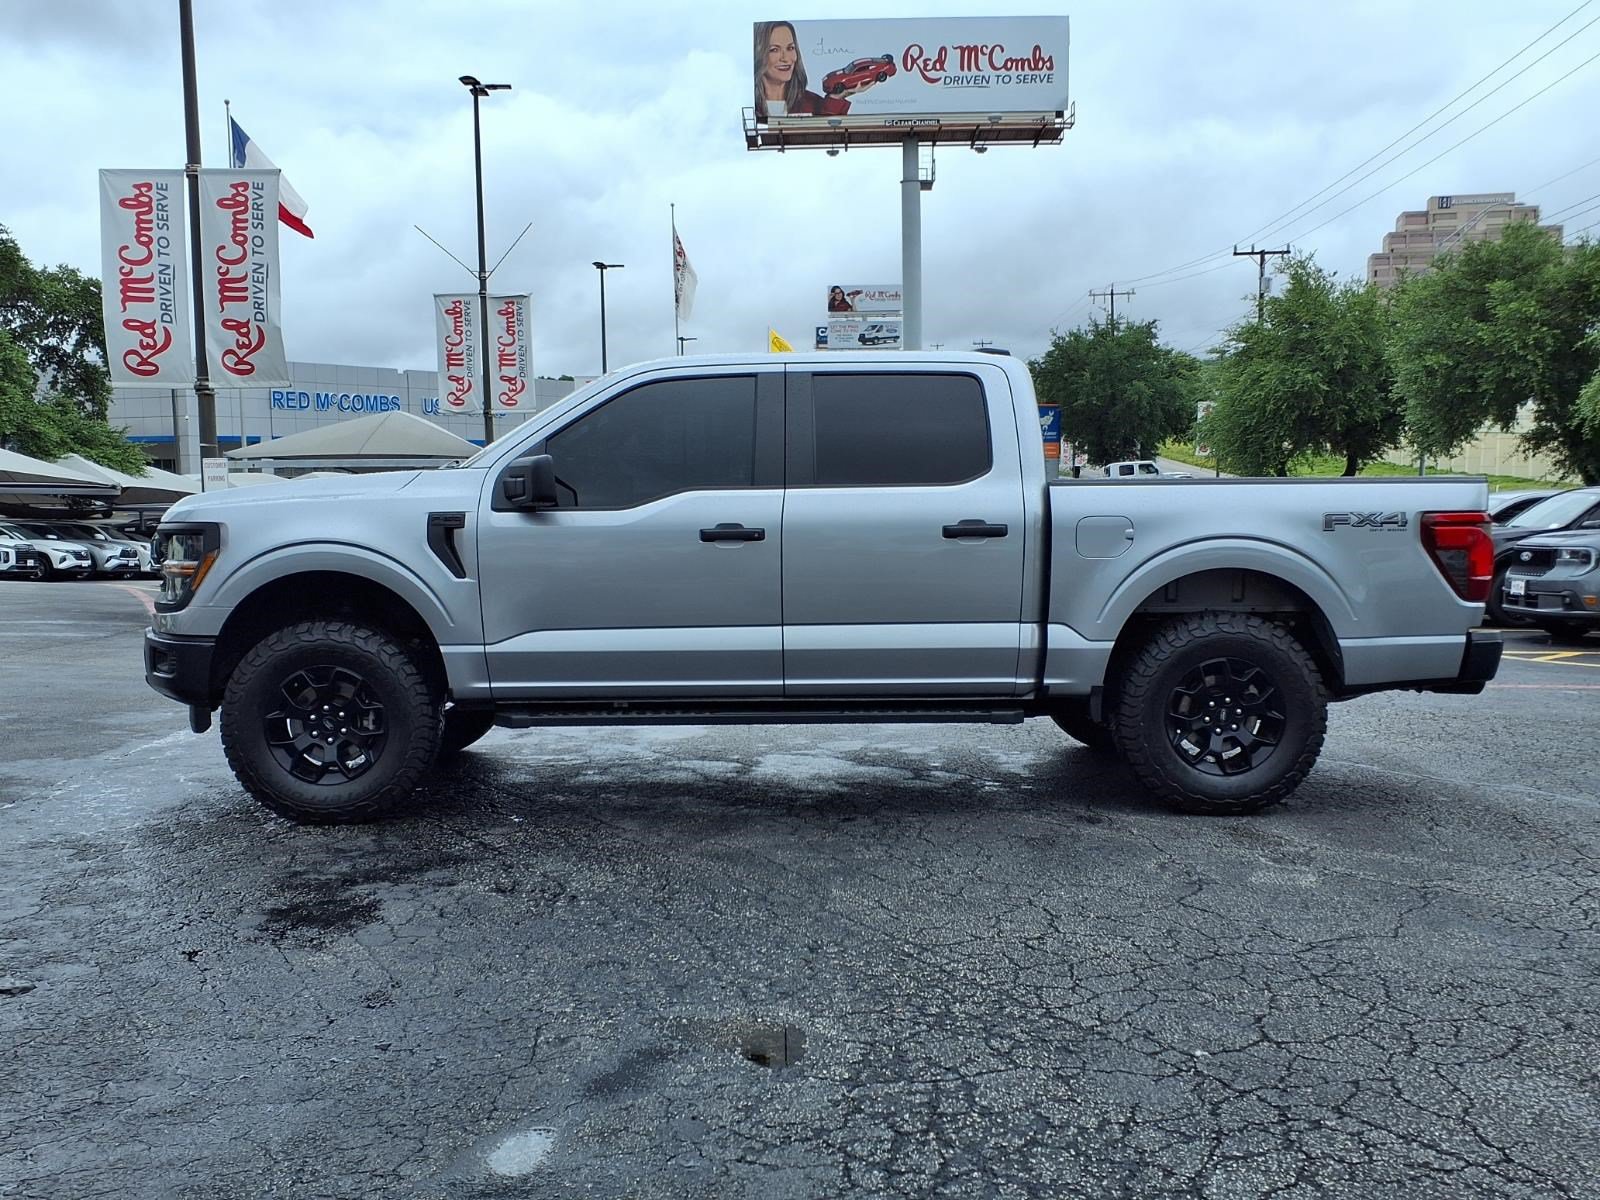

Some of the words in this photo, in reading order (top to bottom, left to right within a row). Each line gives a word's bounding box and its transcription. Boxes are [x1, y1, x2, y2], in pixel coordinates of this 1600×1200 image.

[902, 43, 948, 83] Red
[952, 44, 1054, 72] McCombs
[943, 75, 990, 86] DRIVEN
[994, 75, 1012, 85] TO
[1016, 74, 1054, 84] SERVE
[156, 182, 170, 231] SERVE
[252, 181, 264, 231] SERVE
[118, 181, 155, 313] McCombs
[157, 236, 170, 258] TO
[216, 181, 250, 313] McCombs
[252, 236, 265, 257] TO
[157, 264, 173, 324] DRIVEN
[253, 263, 265, 323] DRIVEN
[123, 319, 172, 377] Red
[221, 318, 266, 376] Red
[445, 300, 464, 372] McCombs
[465, 331, 472, 342] TO
[497, 300, 517, 372] McCombs
[517, 331, 524, 342] TO
[272, 391, 310, 409] RED
[447, 375, 472, 407] Red
[498, 375, 525, 407] Red
[1322, 511, 1408, 532] FX4
